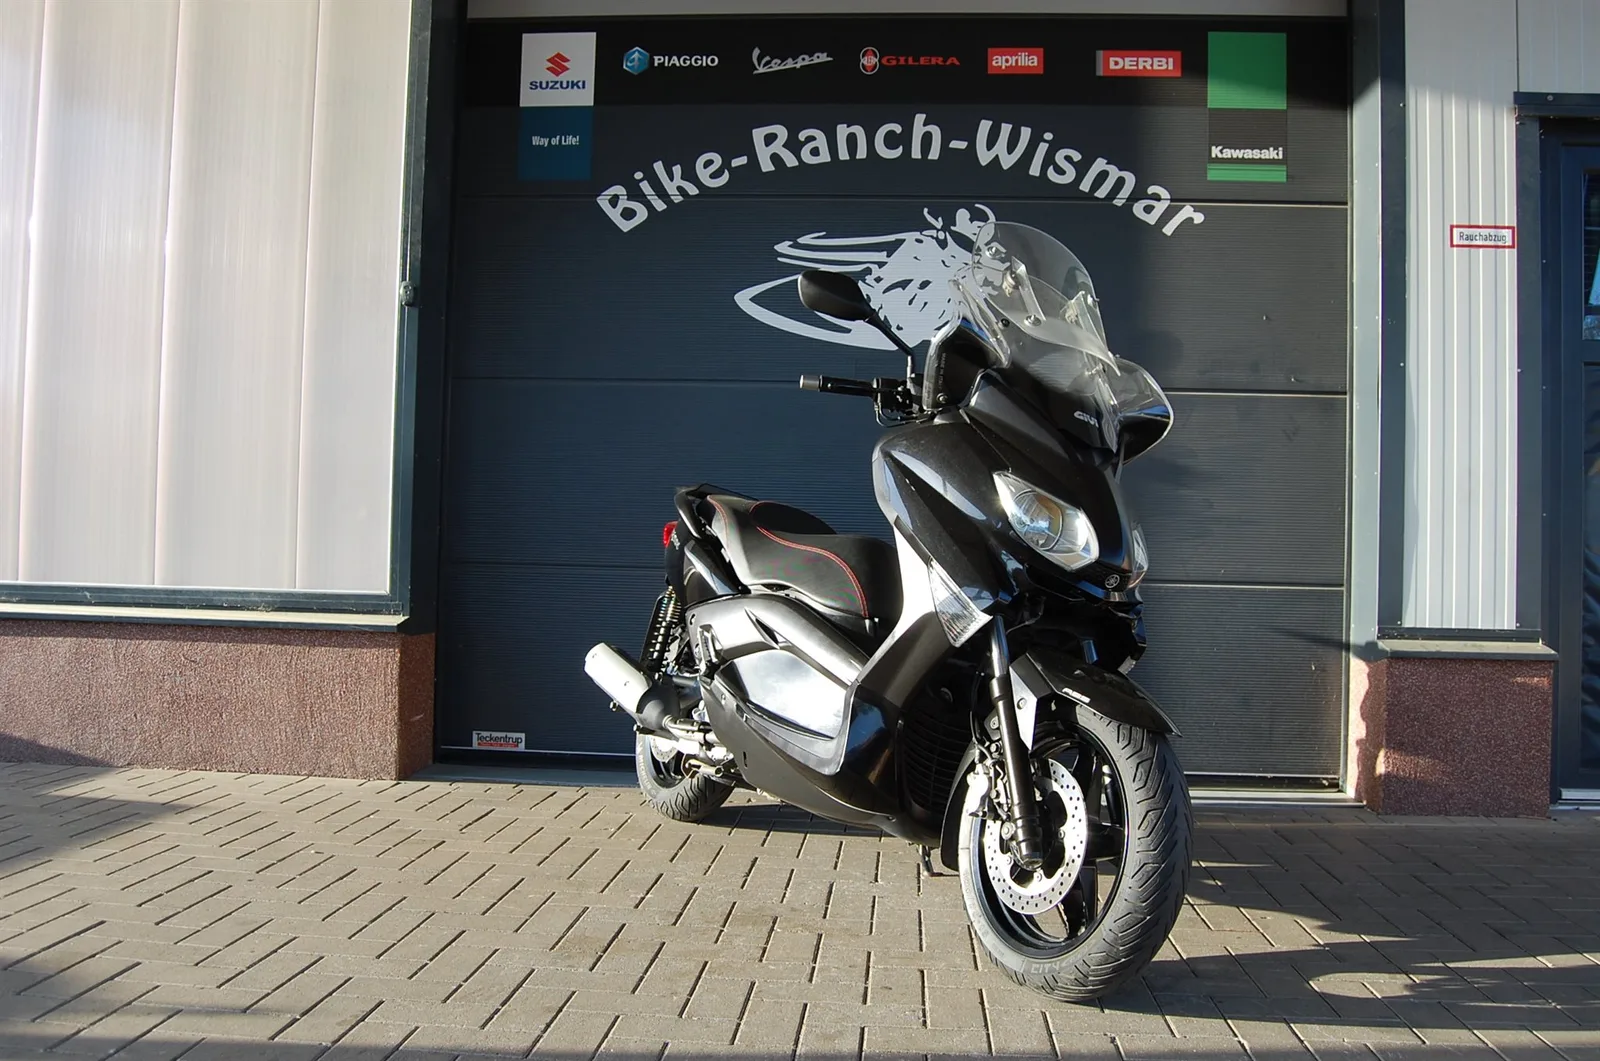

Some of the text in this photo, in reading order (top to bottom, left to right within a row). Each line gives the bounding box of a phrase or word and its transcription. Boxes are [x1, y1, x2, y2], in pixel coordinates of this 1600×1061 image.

[653, 55, 719, 68] PIAGGIO
[752, 47, 834, 75] Vespa
[881, 55, 961, 66] GILERA
[991, 52, 1038, 69] aprilia
[1108, 56, 1175, 70] DERBI
[528, 80, 586, 91] SUZUKI
[532, 134, 580, 147] Way of Life!
[1210, 145, 1284, 160] Kawasaki
[1459, 231, 1507, 244] Rauchabzug
[475, 732, 523, 744] Teckentrup
[1030, 961, 1060, 974] CITY
